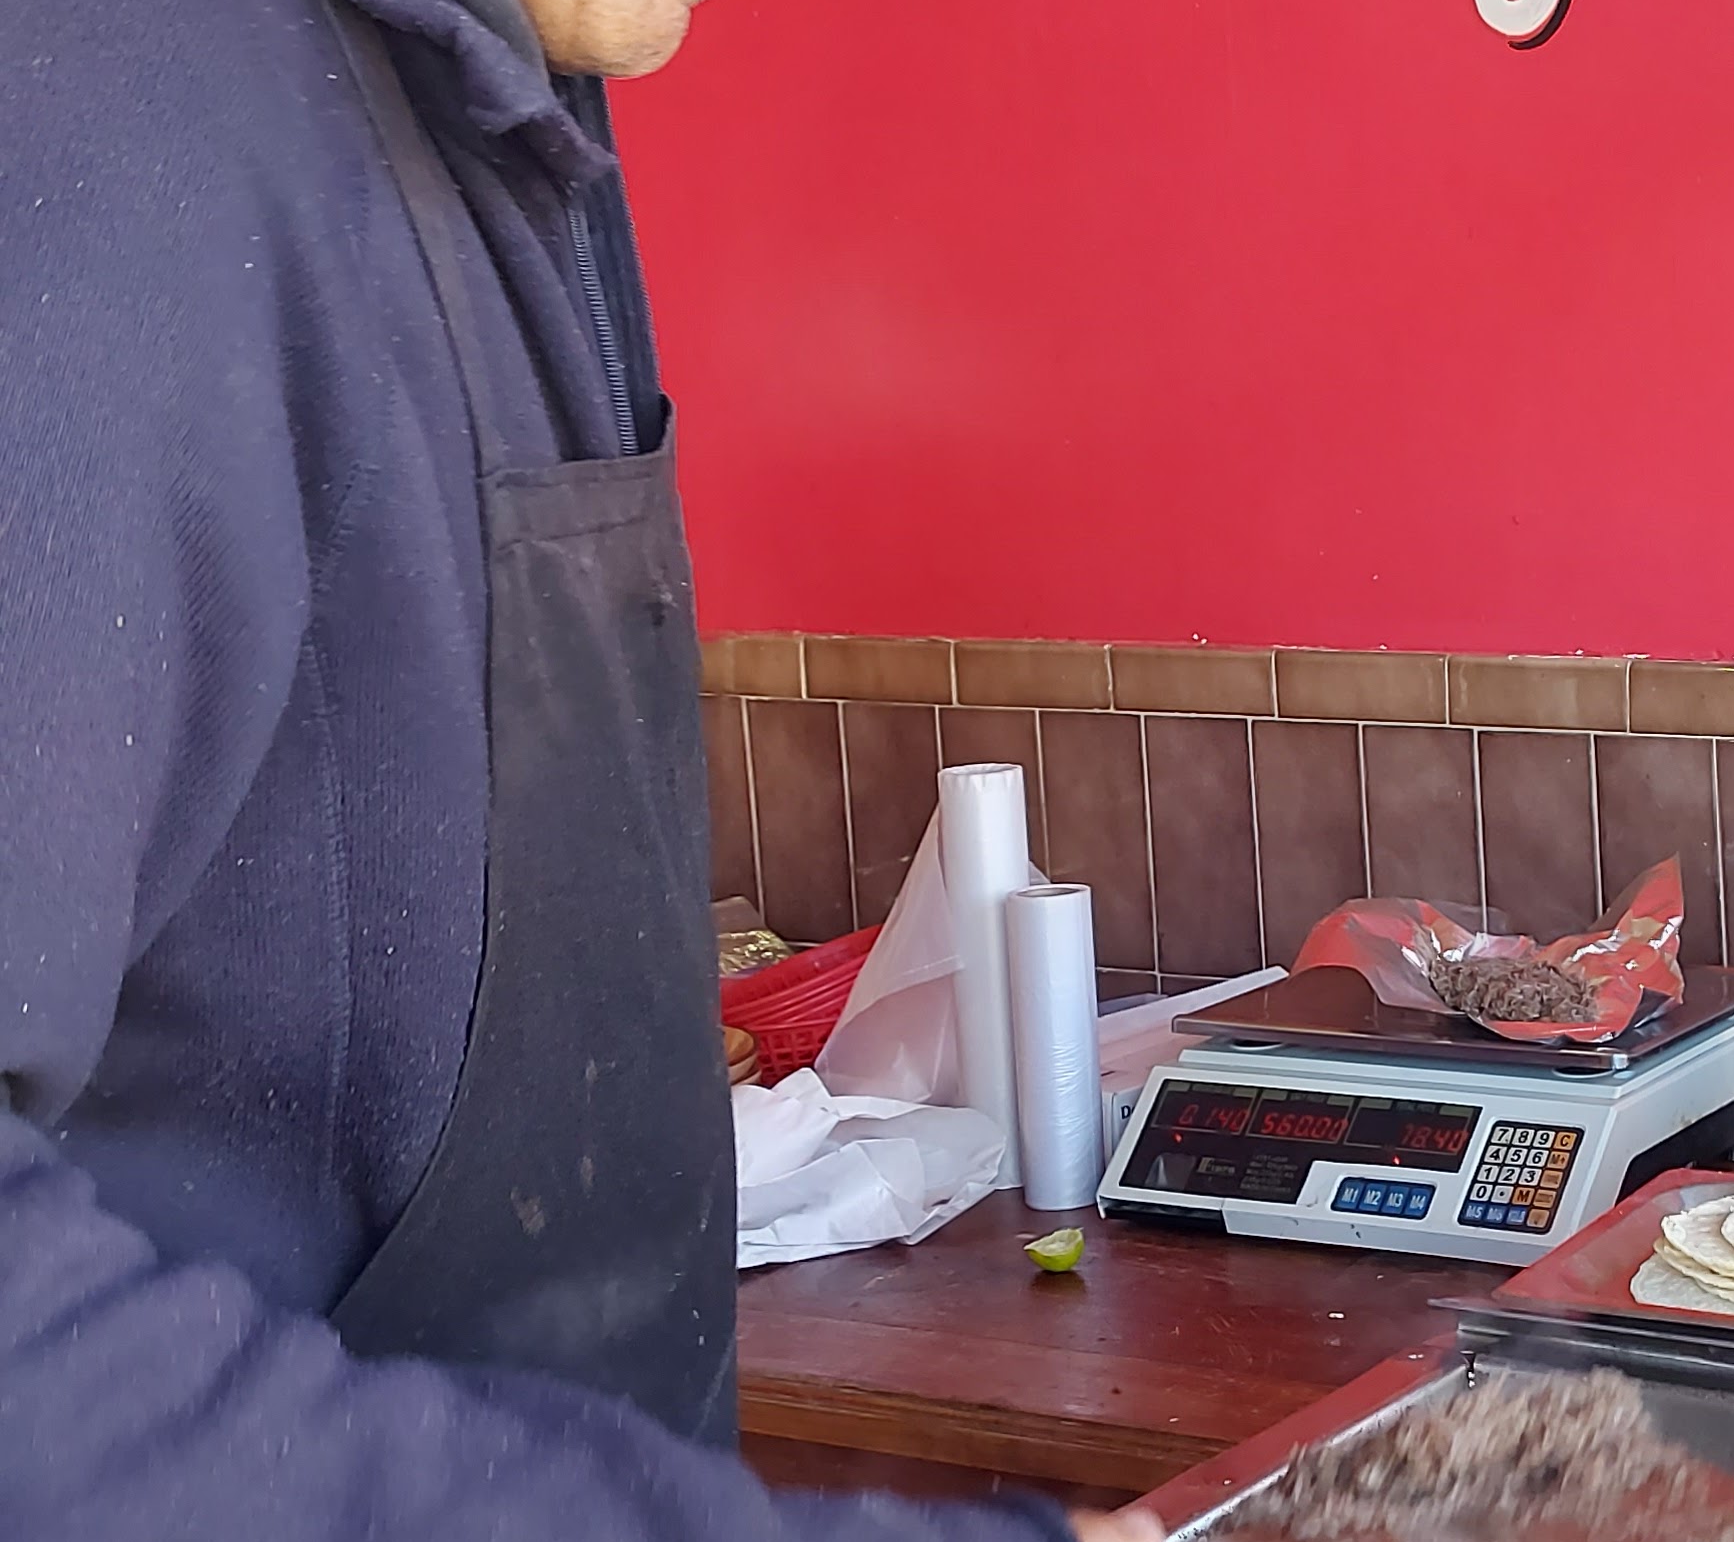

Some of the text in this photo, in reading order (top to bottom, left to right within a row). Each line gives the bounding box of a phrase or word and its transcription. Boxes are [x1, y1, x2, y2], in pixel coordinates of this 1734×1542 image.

[1499, 1128, 1571, 1147] 7 8 9 C
[1489, 1148, 1501, 1161] 4
[1510, 1149, 1522, 1162] 5
[1532, 1151, 1544, 1164] 6
[1484, 1166, 1493, 1180] 1
[1502, 1168, 1515, 1181] 2
[1524, 1170, 1536, 1183] 3
[1341, 1188, 1359, 1203] M1
[1363, 1189, 1381, 1206] M2
[1386, 1192, 1404, 1208] M3
[1476, 1185, 1487, 1199] 0
[1517, 1190, 1530, 1203] M
